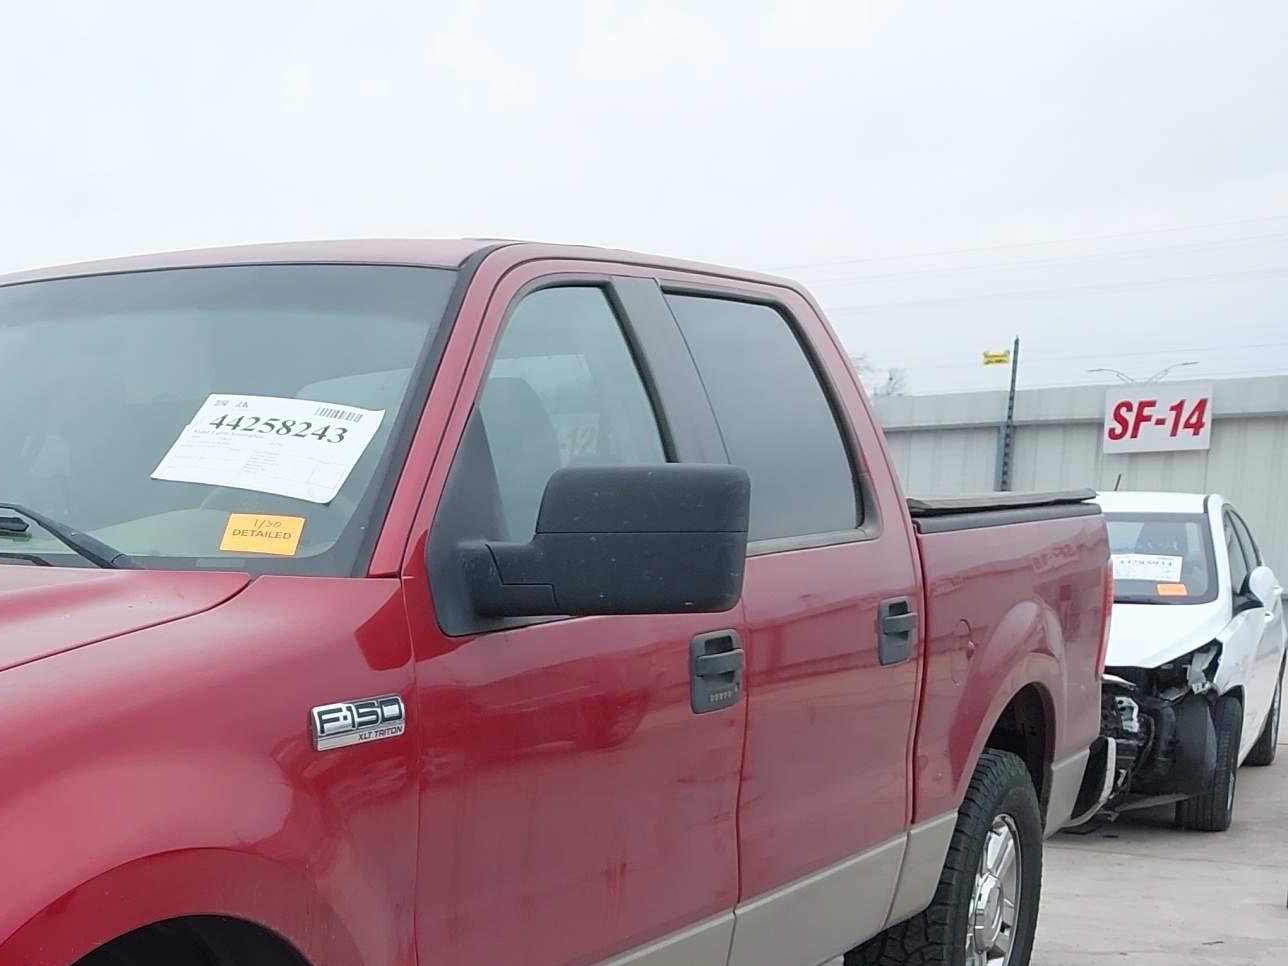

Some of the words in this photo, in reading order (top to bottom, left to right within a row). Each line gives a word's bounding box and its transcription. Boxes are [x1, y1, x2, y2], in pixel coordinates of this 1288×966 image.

[209, 414, 348, 443] 44258243
[1108, 398, 1209, 440] SF-14
[232, 528, 292, 540] DETAILED
[358, 733, 373, 741] XLT
[374, 726, 403, 738] TRITON
